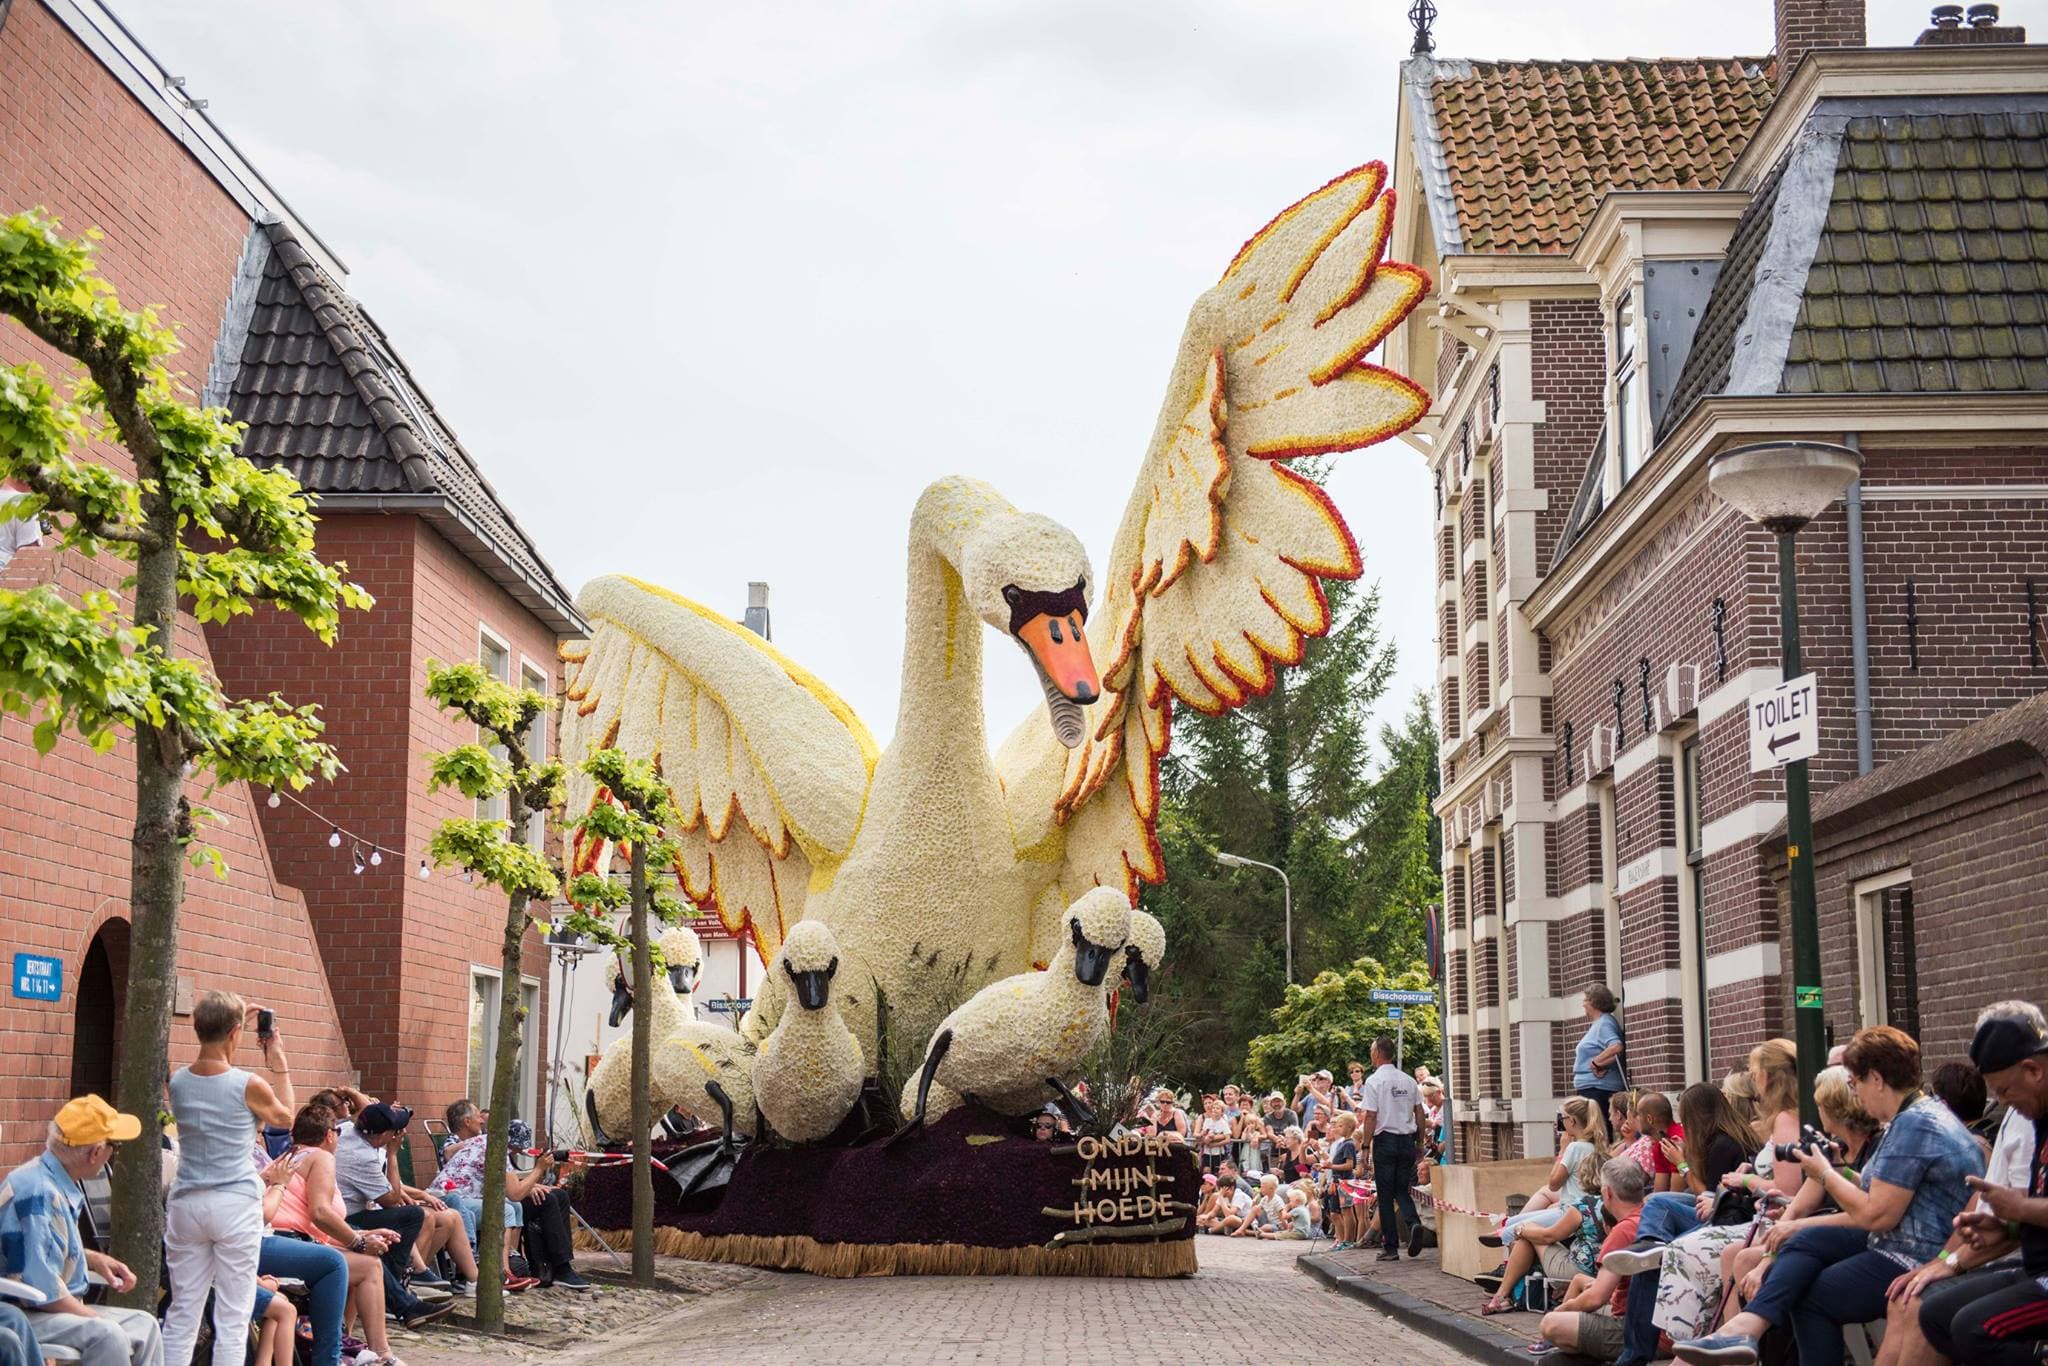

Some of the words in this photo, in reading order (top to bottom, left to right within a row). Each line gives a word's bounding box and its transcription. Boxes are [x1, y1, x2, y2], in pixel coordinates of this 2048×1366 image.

[1755, 686, 1811, 731] TOILET
[1373, 991, 1432, 1001] Bisschopstraat
[1077, 1133, 1172, 1159] ONDER
[1090, 1165, 1154, 1196] MIJN
[1074, 1193, 1174, 1225] HOEDE
